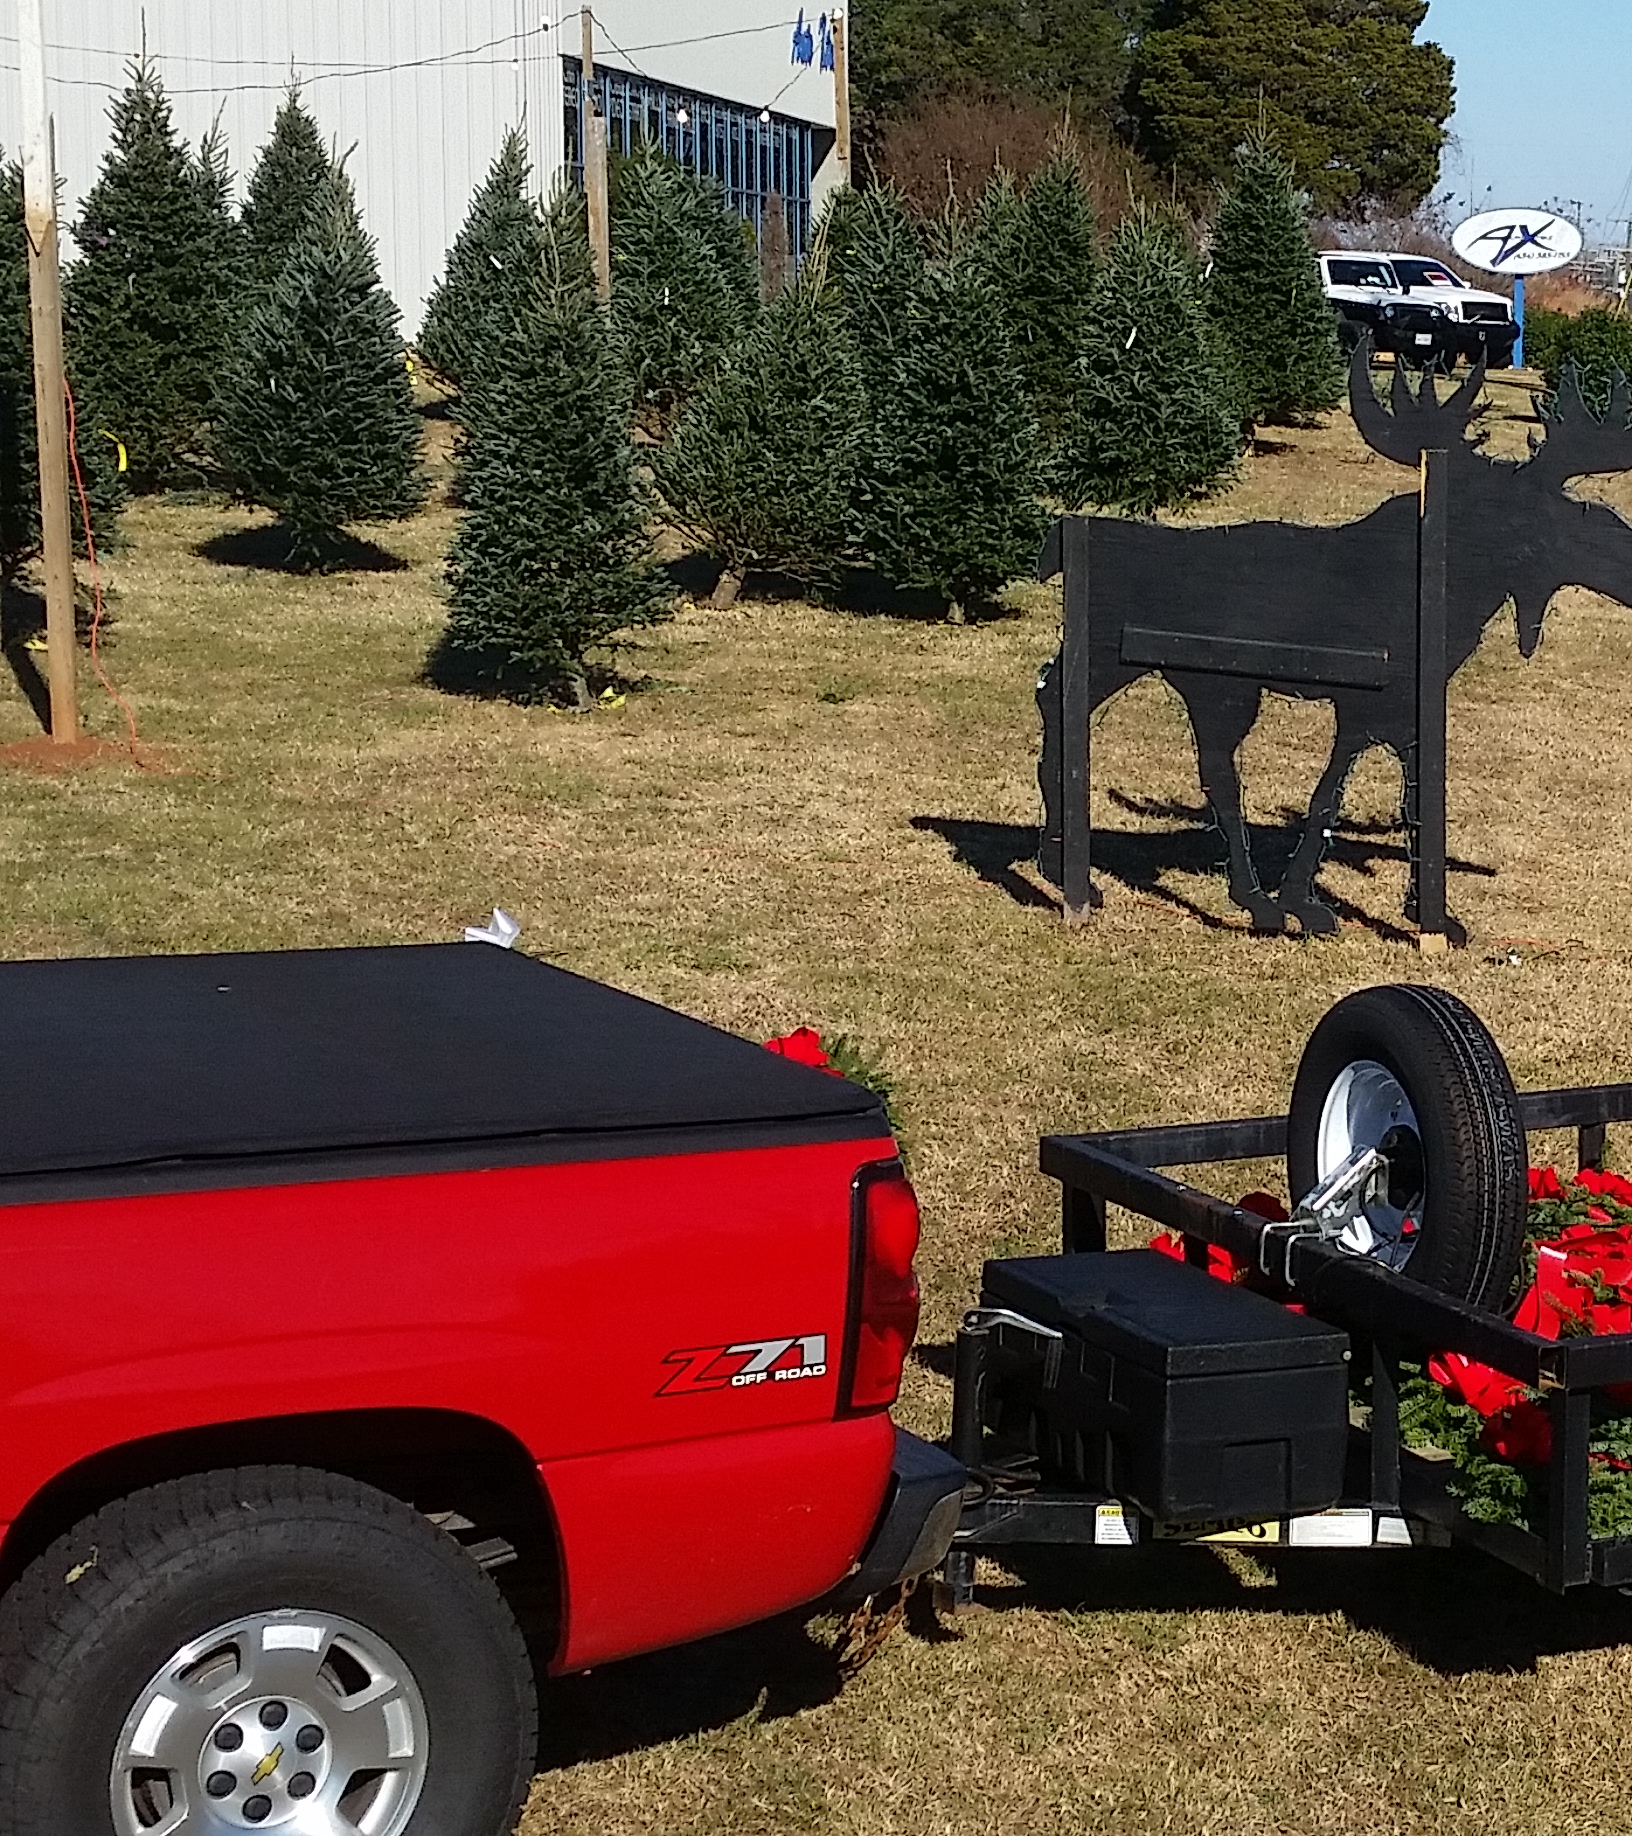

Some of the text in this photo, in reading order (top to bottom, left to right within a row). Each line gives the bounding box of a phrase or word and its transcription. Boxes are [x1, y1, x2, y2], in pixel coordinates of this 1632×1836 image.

[653, 1333, 827, 1397] Z71
[731, 1364, 827, 1387] OFF ROAD
